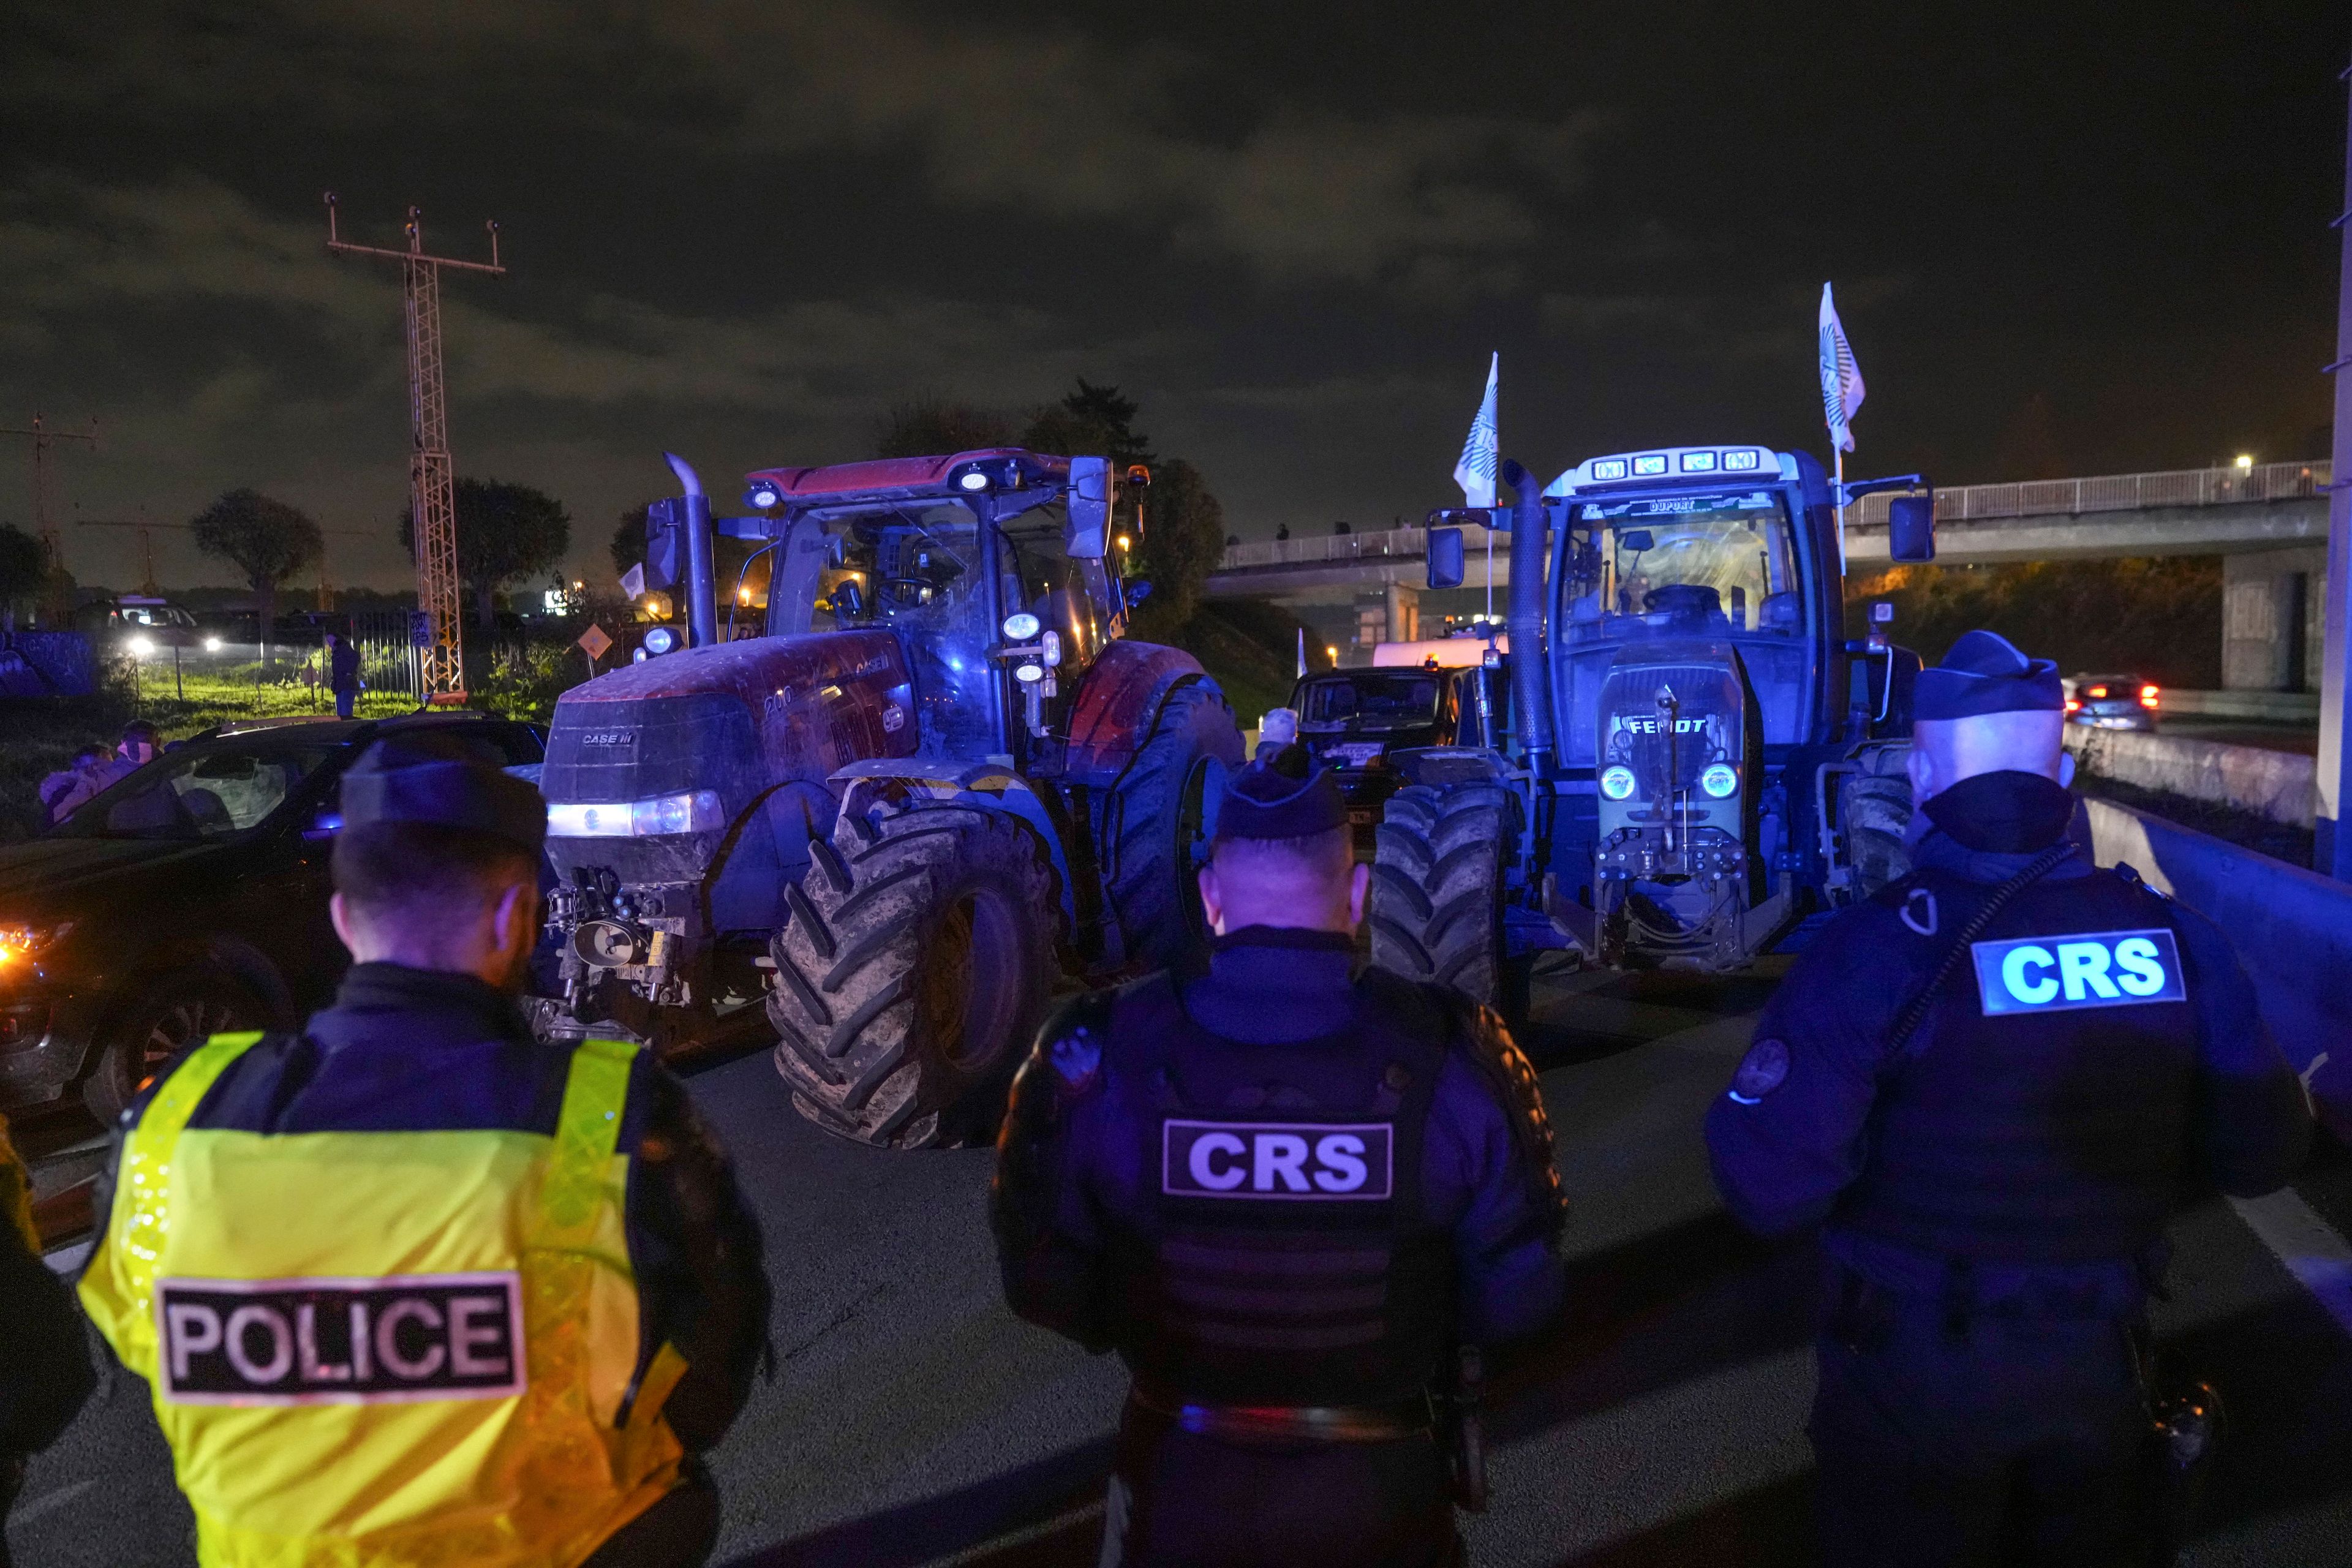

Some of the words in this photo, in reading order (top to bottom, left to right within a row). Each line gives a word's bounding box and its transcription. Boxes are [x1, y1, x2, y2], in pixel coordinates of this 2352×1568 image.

[1649, 500, 1695, 512] DUPORT
[583, 734, 618, 744] CASE
[2002, 937, 2165, 1005] CRS
[1189, 1132, 1368, 1193] CRS
[167, 1297, 508, 1385] POLICE
